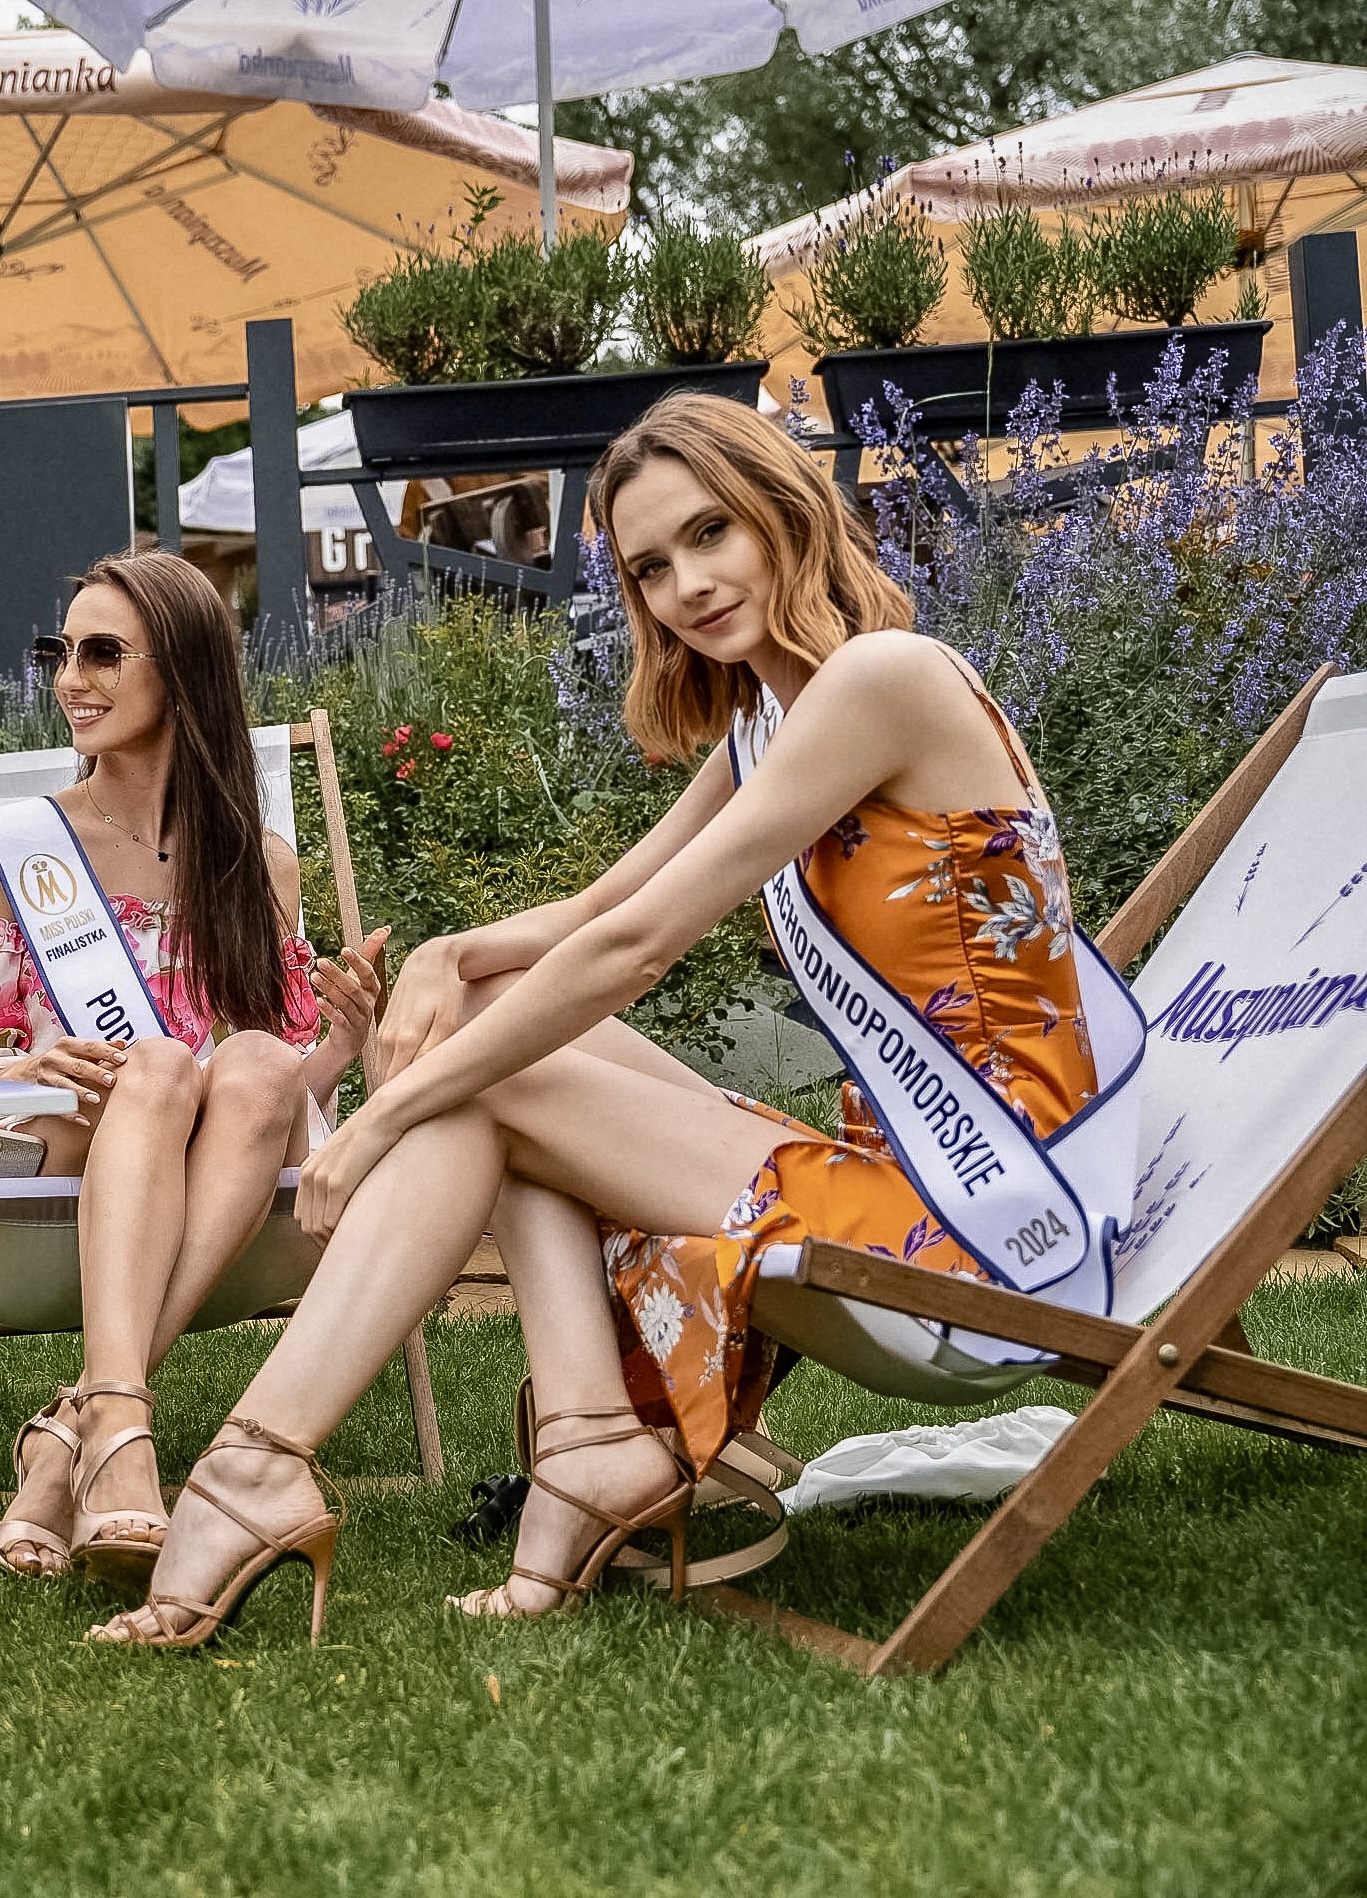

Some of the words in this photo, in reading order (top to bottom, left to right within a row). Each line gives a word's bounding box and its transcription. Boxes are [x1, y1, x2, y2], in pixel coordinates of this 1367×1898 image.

[321, 527, 373, 573] Gr
[39, 920, 65, 941] MISS
[64, 908, 96, 931] POLSKI
[45, 928, 107, 962] FINALISTKA
[85, 987, 137, 1045] POD
[772, 870, 1006, 1197] ACHODNIOPOMORSKIE
[1005, 1208, 1070, 1267] 2024
